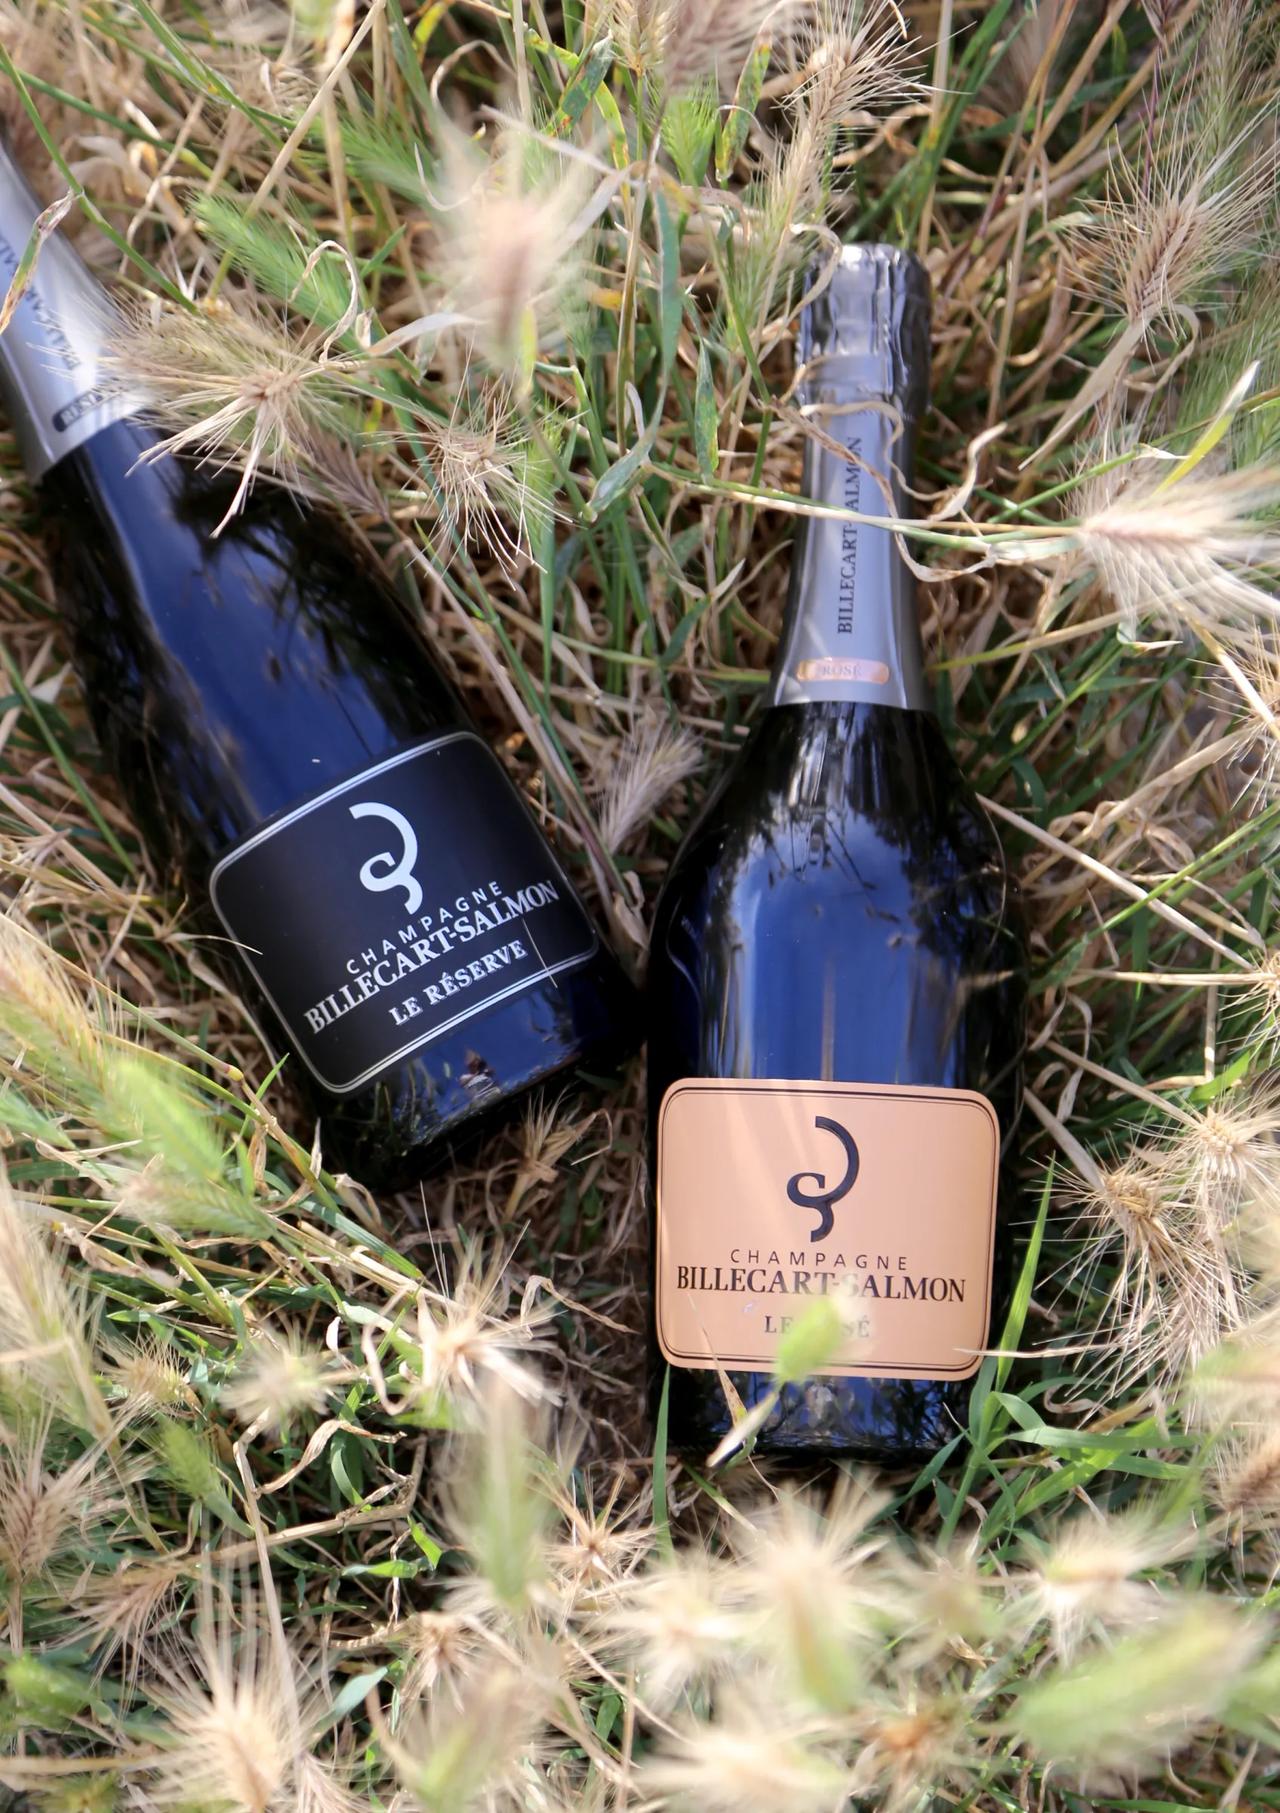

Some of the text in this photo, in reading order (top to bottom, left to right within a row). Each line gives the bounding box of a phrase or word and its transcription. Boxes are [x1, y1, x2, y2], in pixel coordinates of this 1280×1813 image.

[838, 437, 862, 634] BILLECART-ALMON
[303, 880, 560, 1034] BILLECART-SALMON
[346, 881, 502, 974] CHAMPAGNE
[389, 939, 528, 1026] LE RÉSERVE
[730, 1249, 907, 1270] CHAMPAGNE
[765, 1316, 792, 1334] LE
